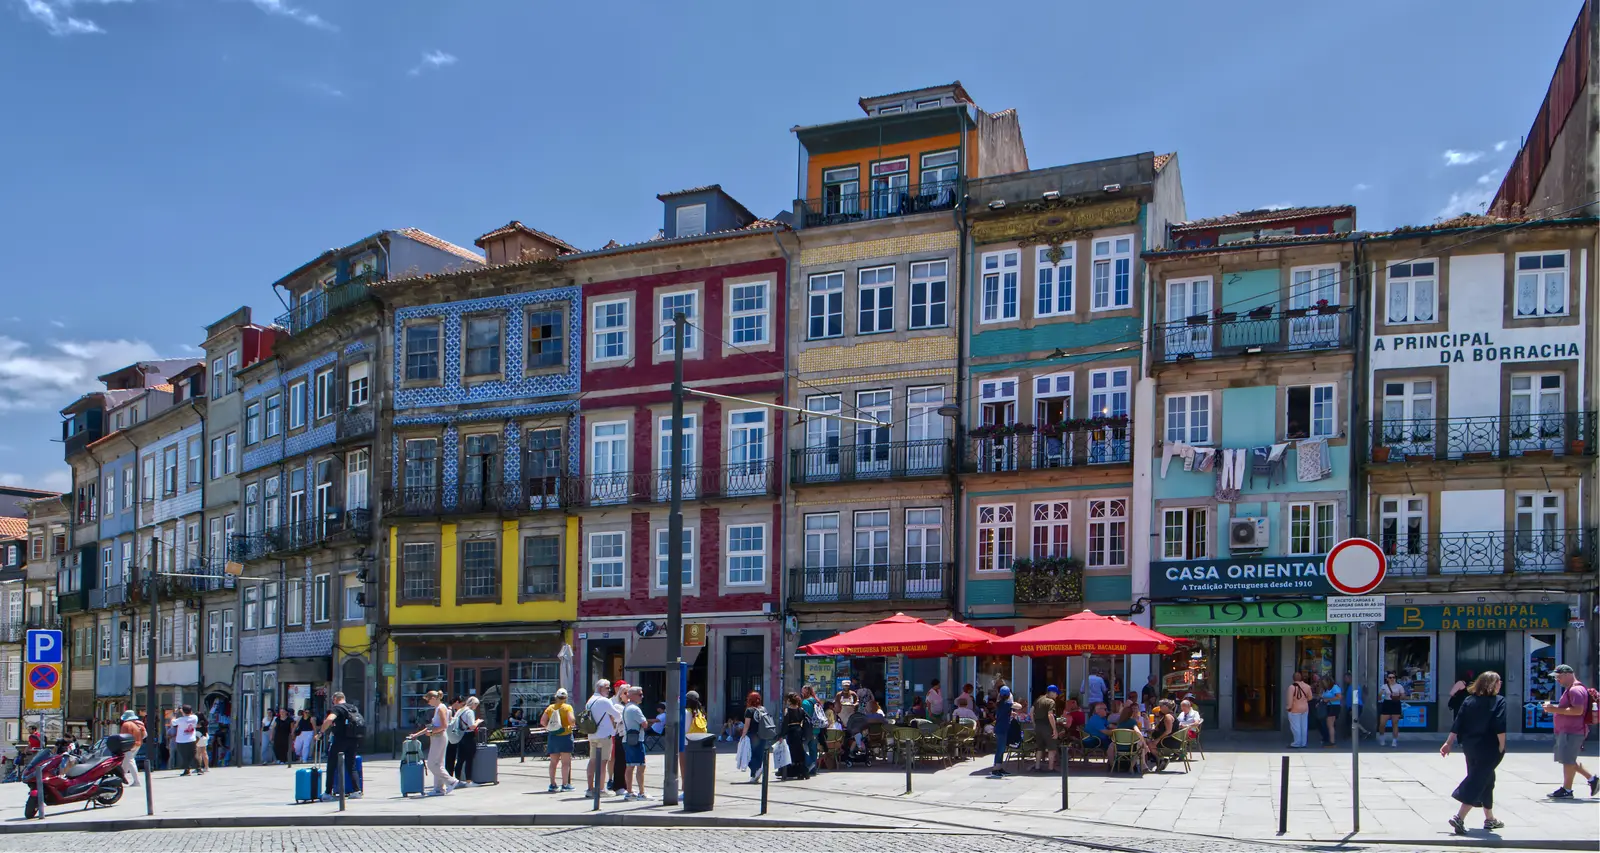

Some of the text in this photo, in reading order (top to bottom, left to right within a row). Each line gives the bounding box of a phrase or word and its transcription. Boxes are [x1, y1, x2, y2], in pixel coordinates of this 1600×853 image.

[1374, 332, 1494, 351] A PRINCIPAL
[1440, 342, 1580, 364] DA BORRACHA
[1165, 562, 1326, 581] CASA ORIENTAL
[1188, 583, 1223, 592] Tradição
[1224, 582, 1269, 591] Portuguesa
[1269, 580, 1293, 588] desde
[1294, 580, 1313, 588] 1910
[1208, 601, 1303, 622] 1910
[1442, 605, 1537, 617] A PRINCIPAL
[1280, 626, 1295, 634] DO
[1300, 625, 1338, 633] PORTO
[1441, 618, 1549, 629] DA BORRACHA
[35, 633, 55, 660] P
[901, 644, 928, 652] BACALHAU
